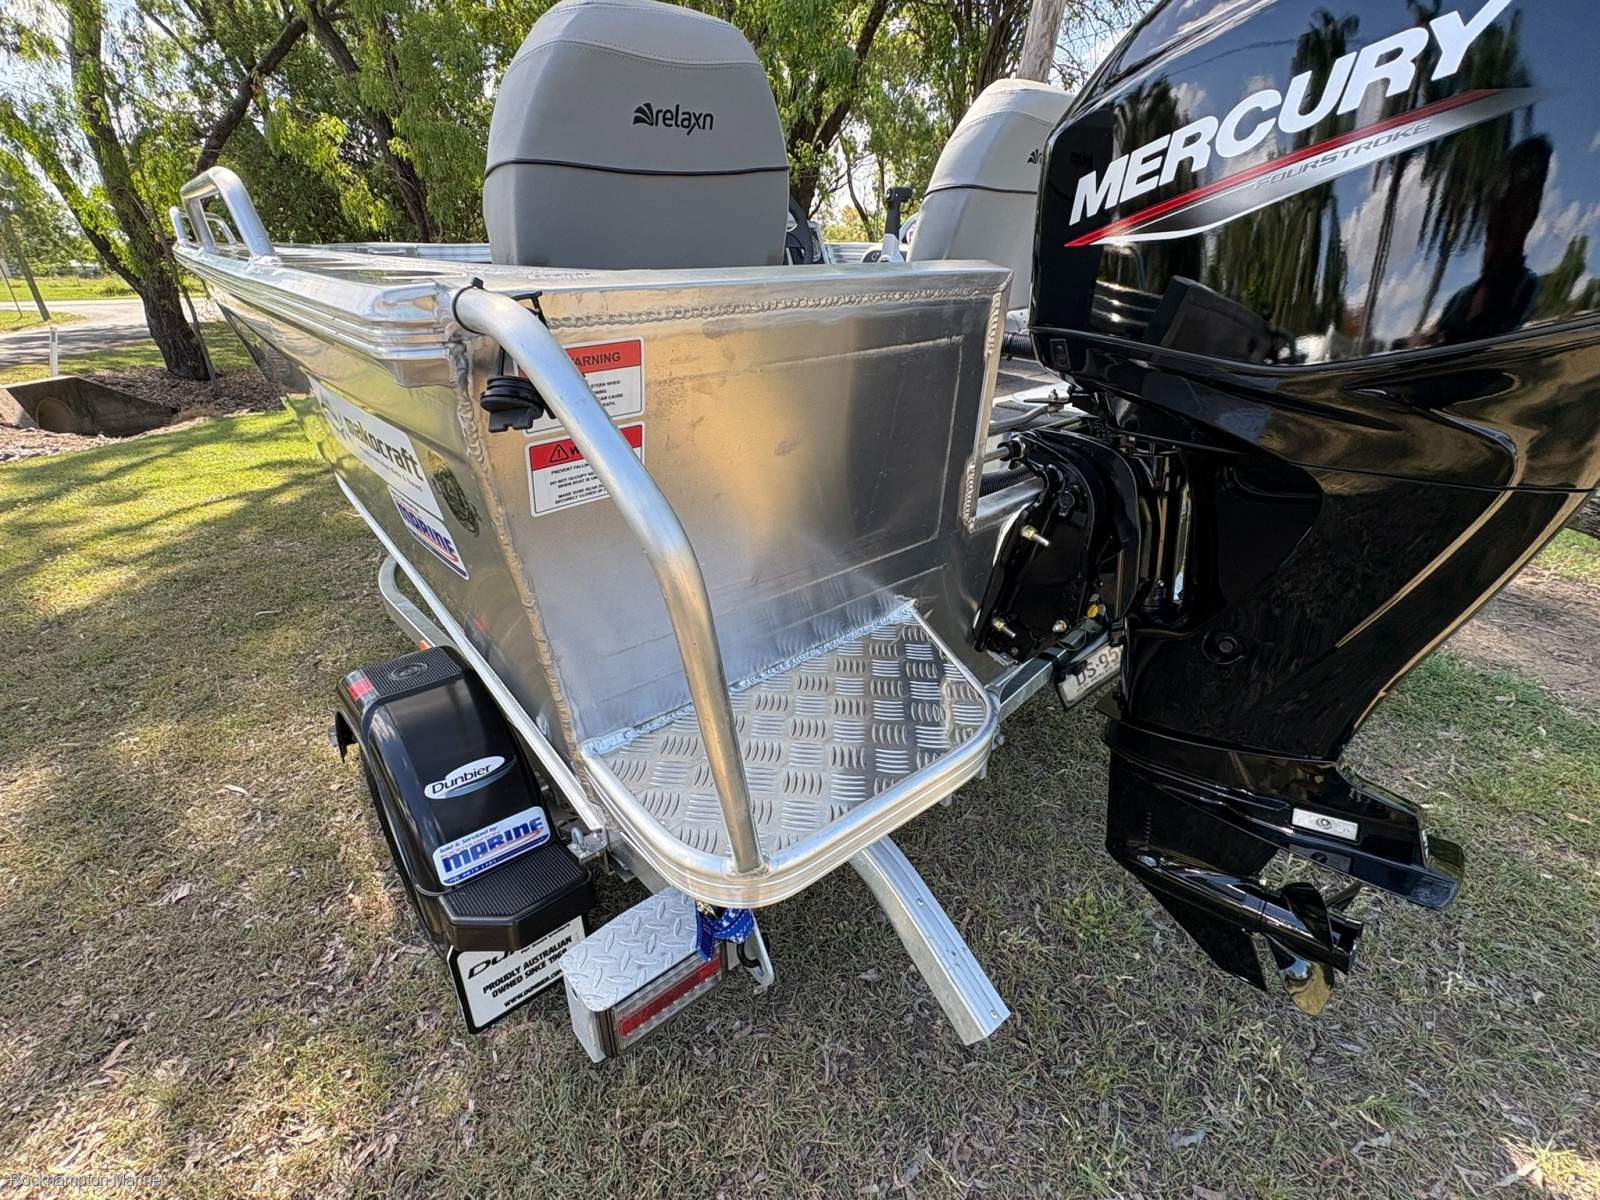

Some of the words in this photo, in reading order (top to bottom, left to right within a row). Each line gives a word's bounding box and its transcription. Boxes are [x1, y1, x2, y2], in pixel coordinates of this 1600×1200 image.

[654, 103, 714, 136] relaxn
[1069, 0, 1507, 226] MERCURY
[1253, 119, 1431, 189] FOURSTROKE
[571, 351, 622, 367] ARNING
[431, 764, 492, 794] Dunbier
[482, 966, 521, 994] PROUDLY
[523, 935, 572, 970] AUSTRALIAN
[492, 976, 523, 998] OWNED
[525, 961, 547, 979] SINCE
